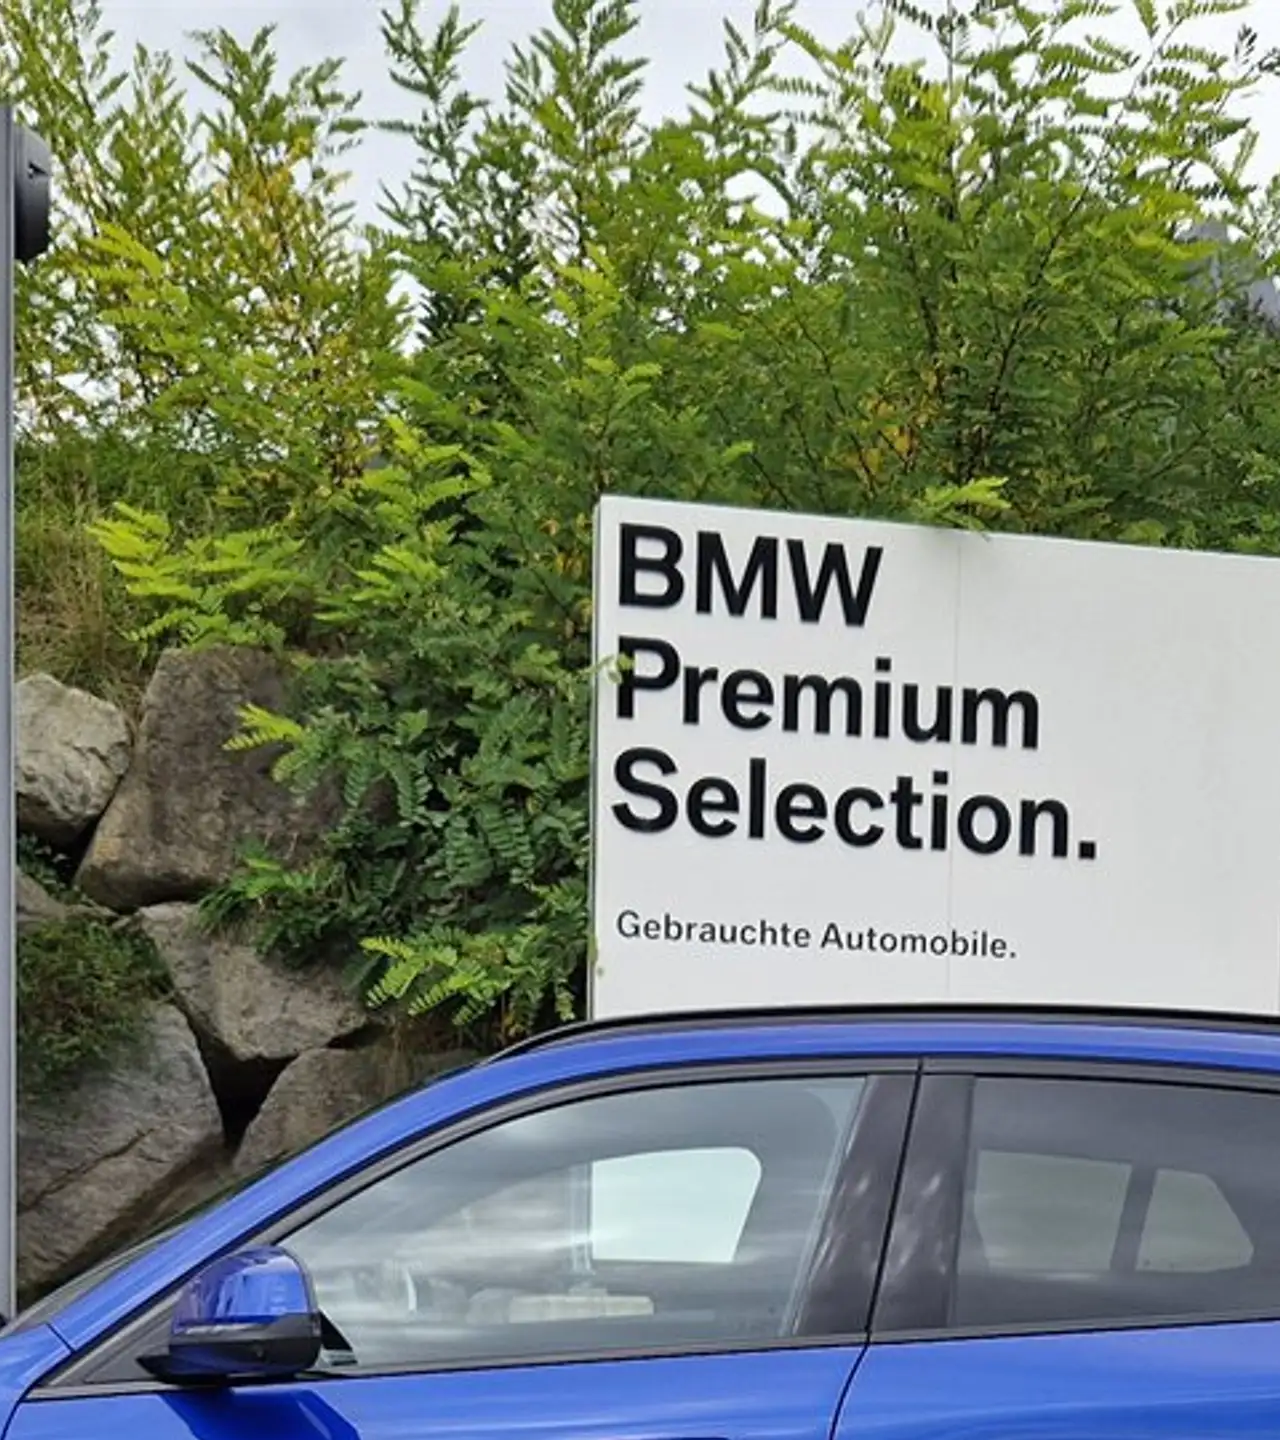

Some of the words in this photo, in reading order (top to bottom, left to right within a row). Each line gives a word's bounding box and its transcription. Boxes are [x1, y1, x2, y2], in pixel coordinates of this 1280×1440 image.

[618, 522, 885, 628] BMW
[614, 635, 1040, 751] Premium
[610, 745, 1098, 862] Selection.
[616, 908, 812, 949] Gebrauchte
[820, 921, 1018, 959] Automobile.
